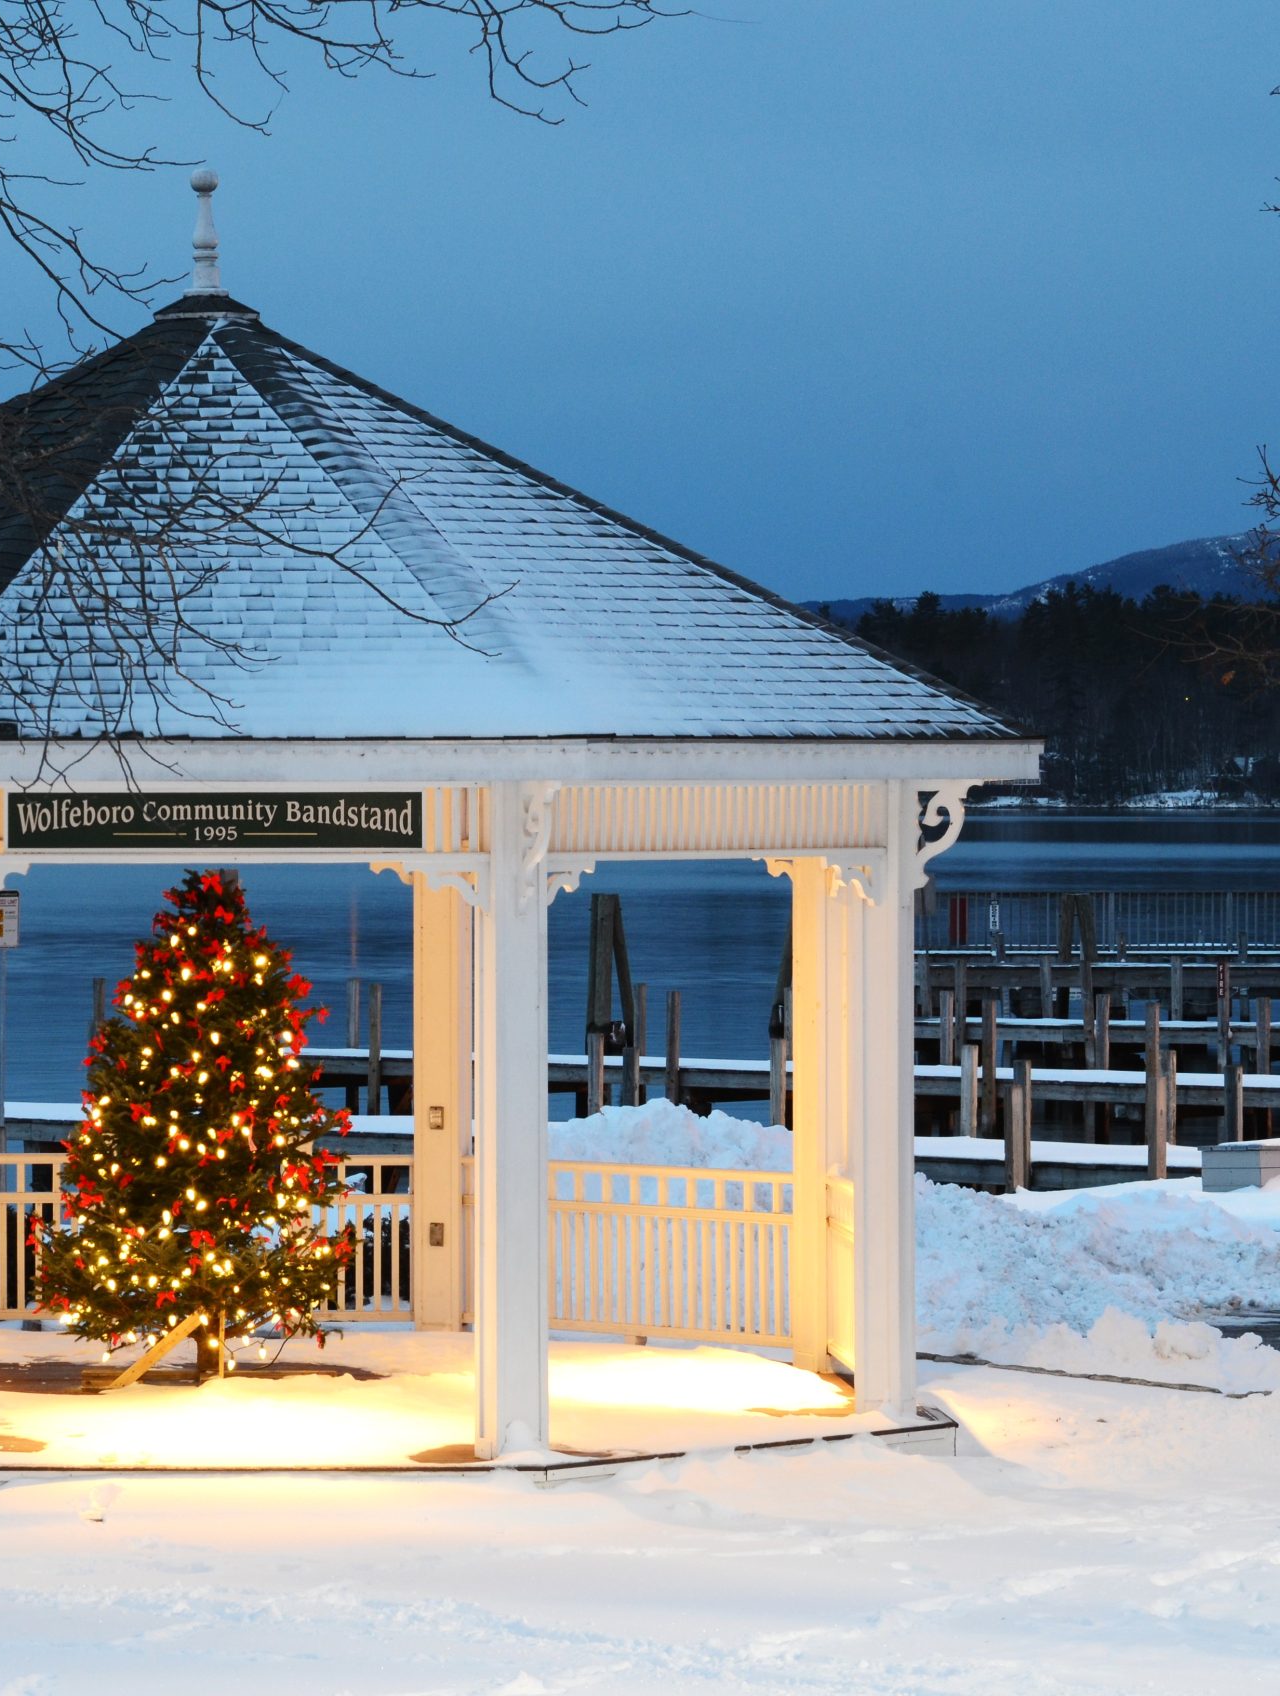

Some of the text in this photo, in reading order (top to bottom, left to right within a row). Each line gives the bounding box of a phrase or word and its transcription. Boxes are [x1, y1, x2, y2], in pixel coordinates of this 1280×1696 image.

[16, 799, 414, 836] Wolfeboro Community Bandstand
[194, 826, 238, 841] 1995
